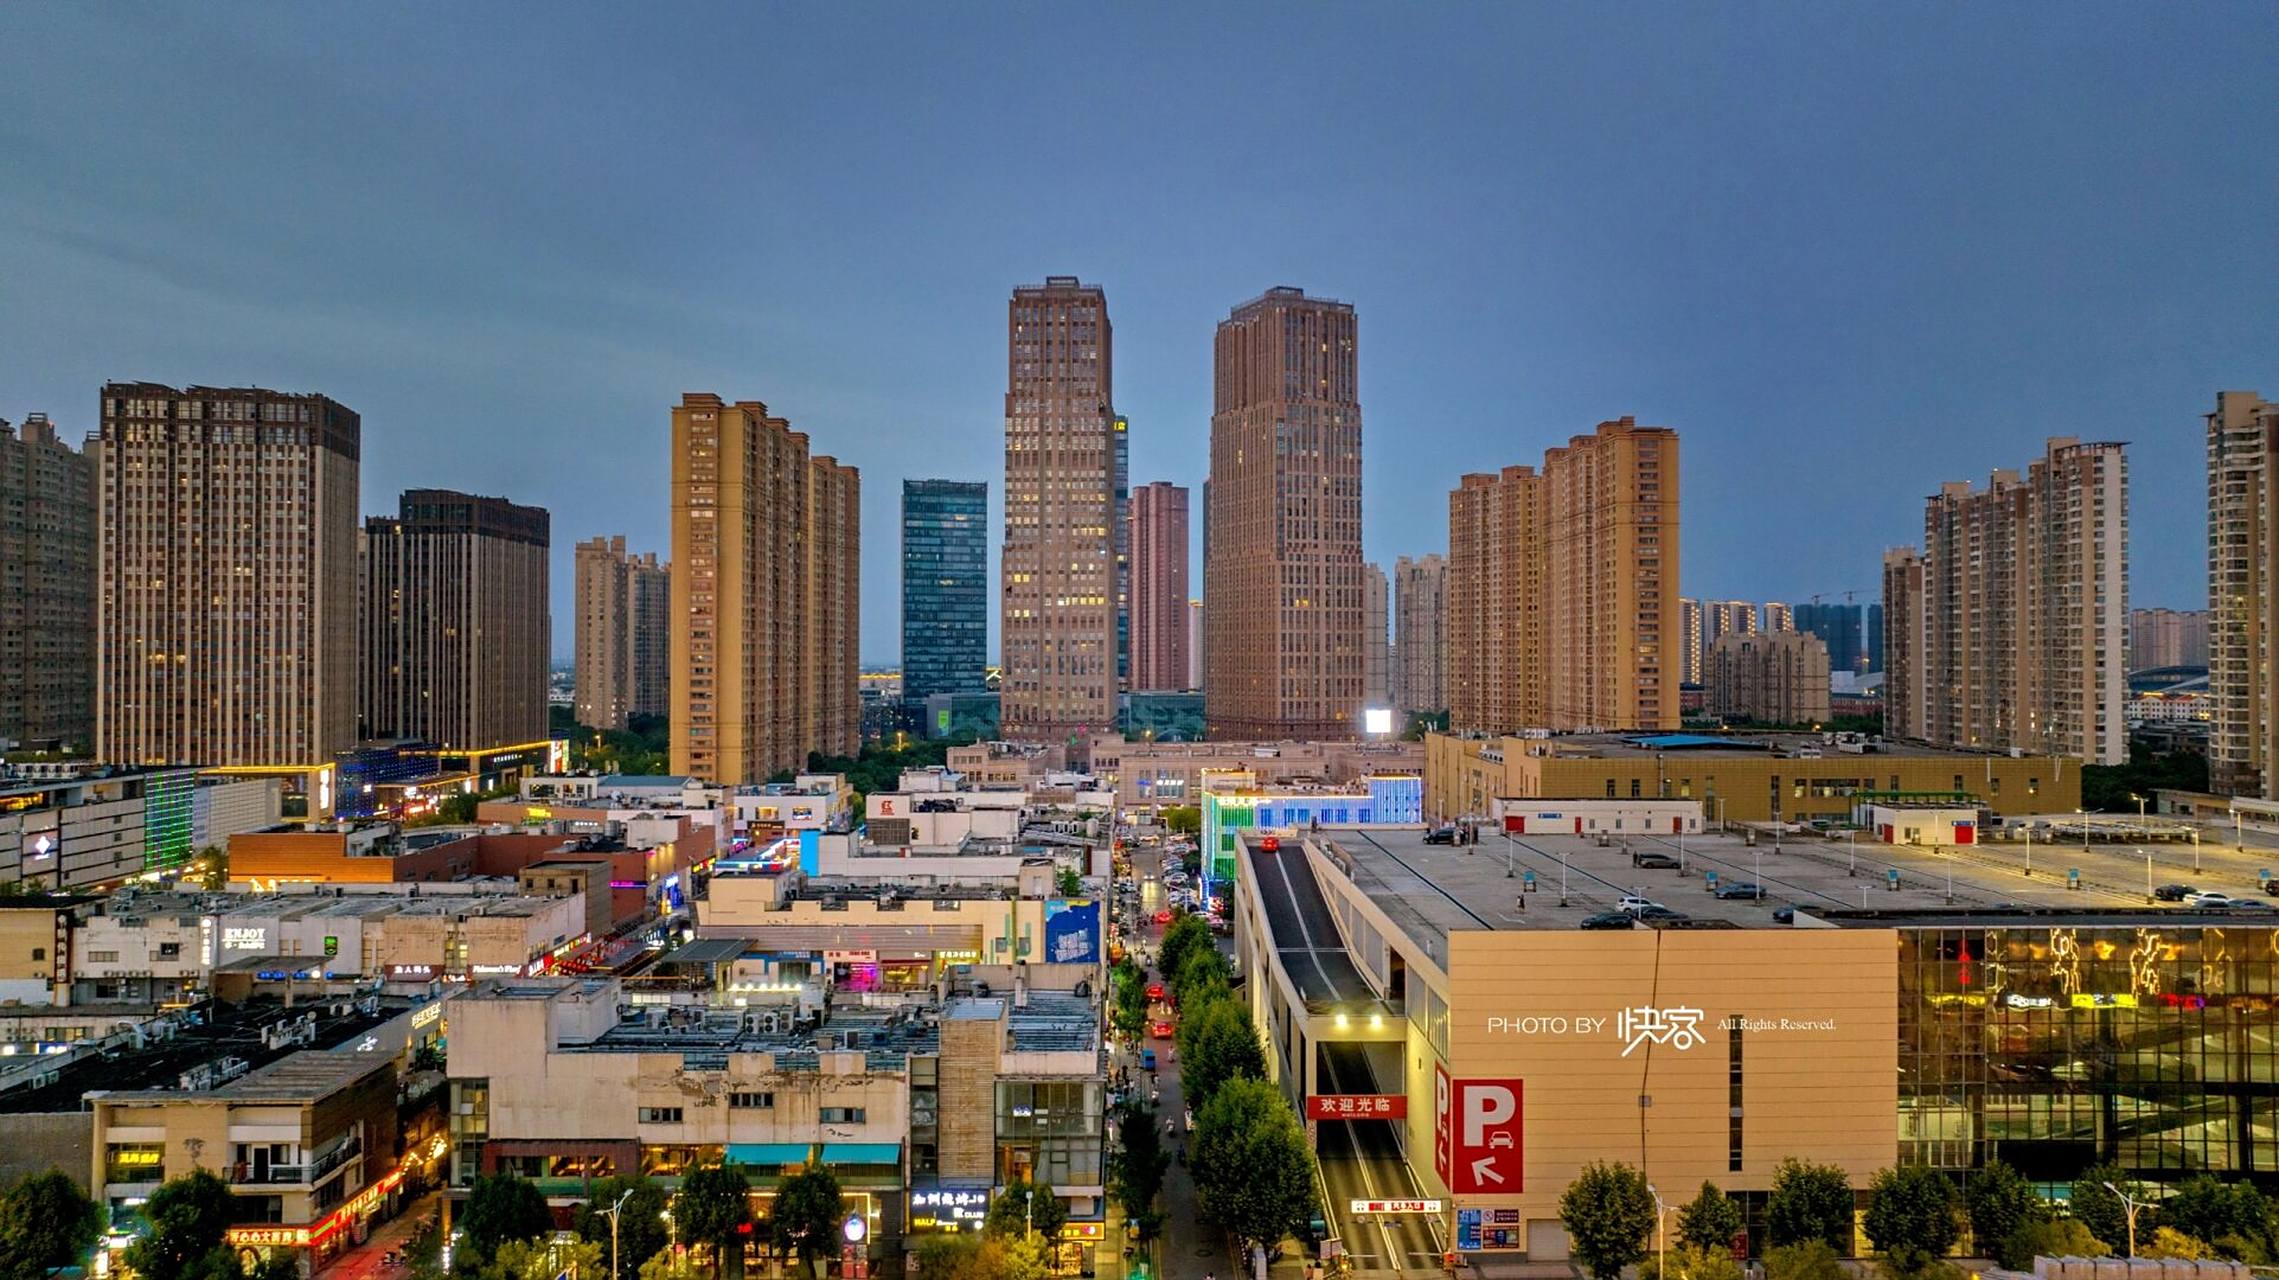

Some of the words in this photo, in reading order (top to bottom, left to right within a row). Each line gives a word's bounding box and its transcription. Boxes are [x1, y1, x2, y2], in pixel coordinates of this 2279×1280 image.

[224, 928, 266, 939] ENJOY
[1320, 1097, 1391, 1113] 欢迎光临
[1436, 1069, 1448, 1132] P
[1463, 1085, 1516, 1147] P
